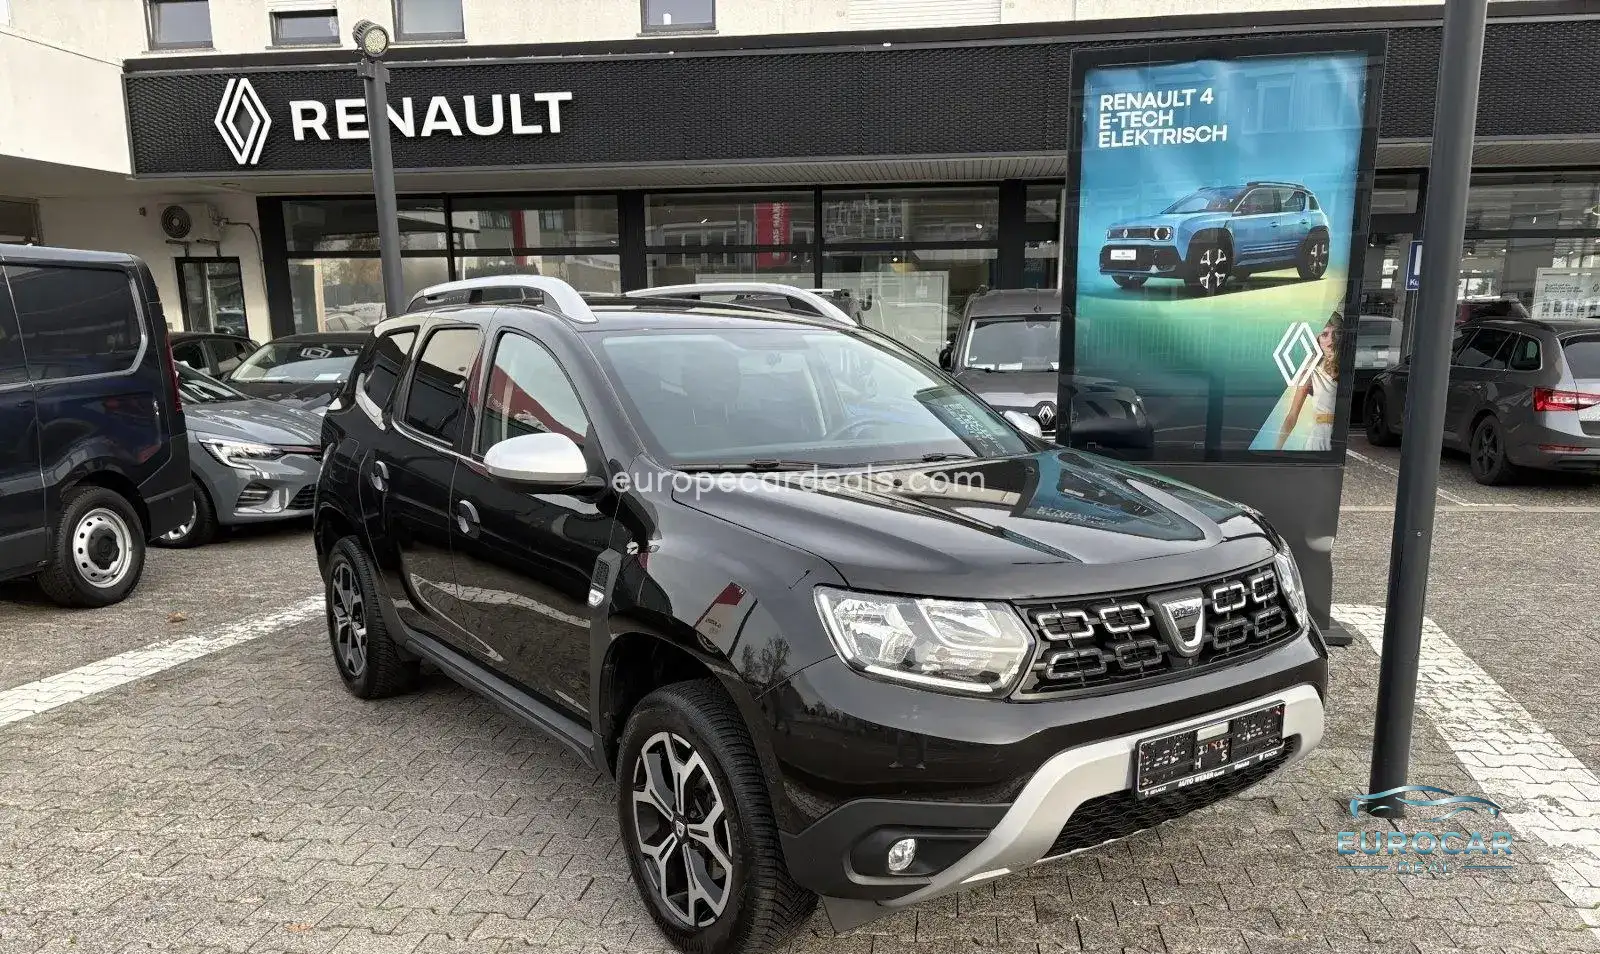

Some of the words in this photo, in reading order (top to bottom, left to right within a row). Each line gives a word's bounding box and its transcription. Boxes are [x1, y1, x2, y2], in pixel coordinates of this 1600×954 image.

[1100, 88, 1197, 111] RENAULT
[1199, 87, 1214, 105] 4
[289, 91, 573, 141] RENAULT
[1099, 109, 1174, 130] E-TECH
[1098, 124, 1228, 148] ELEKTRISCH
